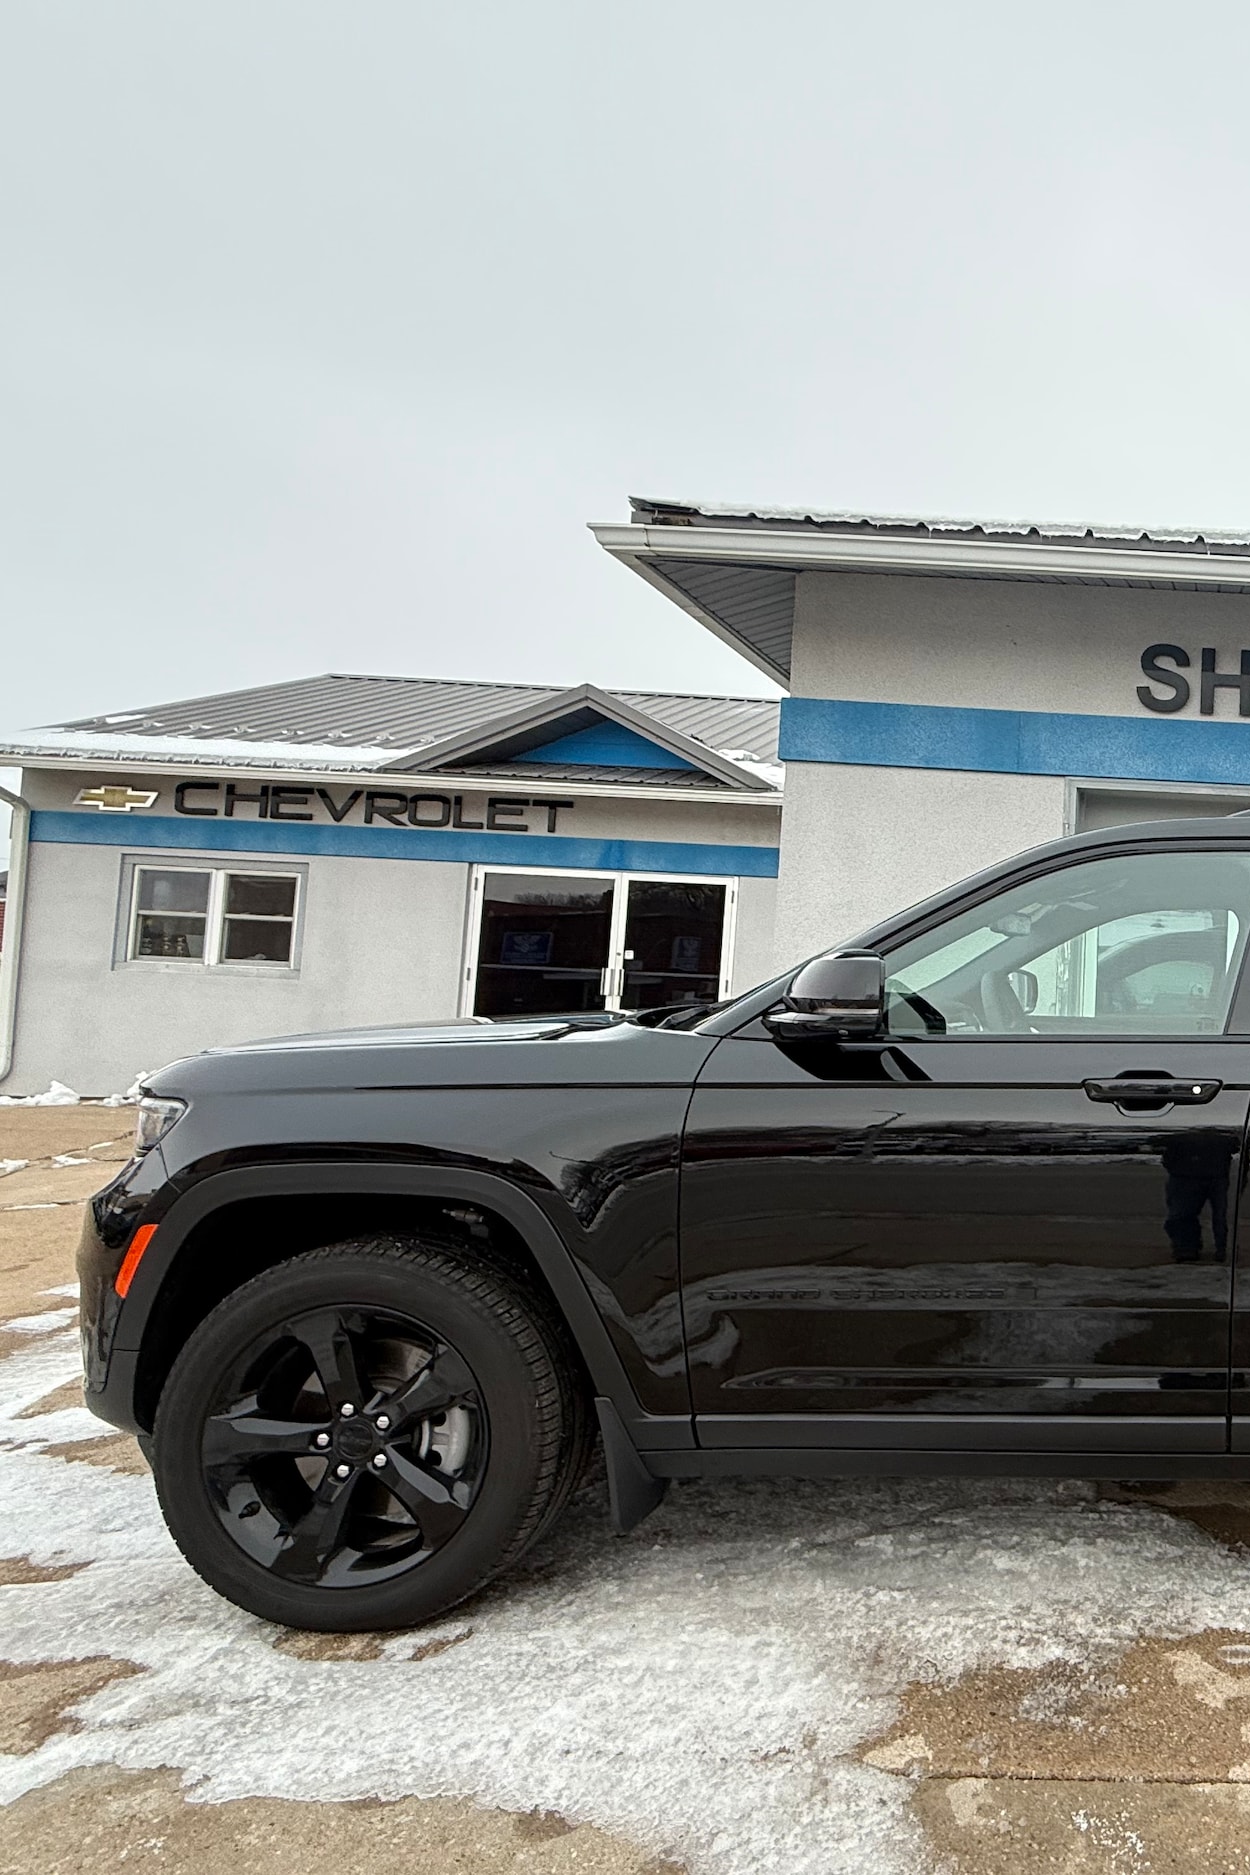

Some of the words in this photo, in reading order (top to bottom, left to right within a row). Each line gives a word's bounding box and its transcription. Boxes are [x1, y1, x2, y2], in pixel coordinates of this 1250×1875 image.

[174, 782, 574, 833] CHEVROLET
[707, 1288, 821, 1301] GRAND
[831, 1288, 1006, 1301] CHEROKEE
